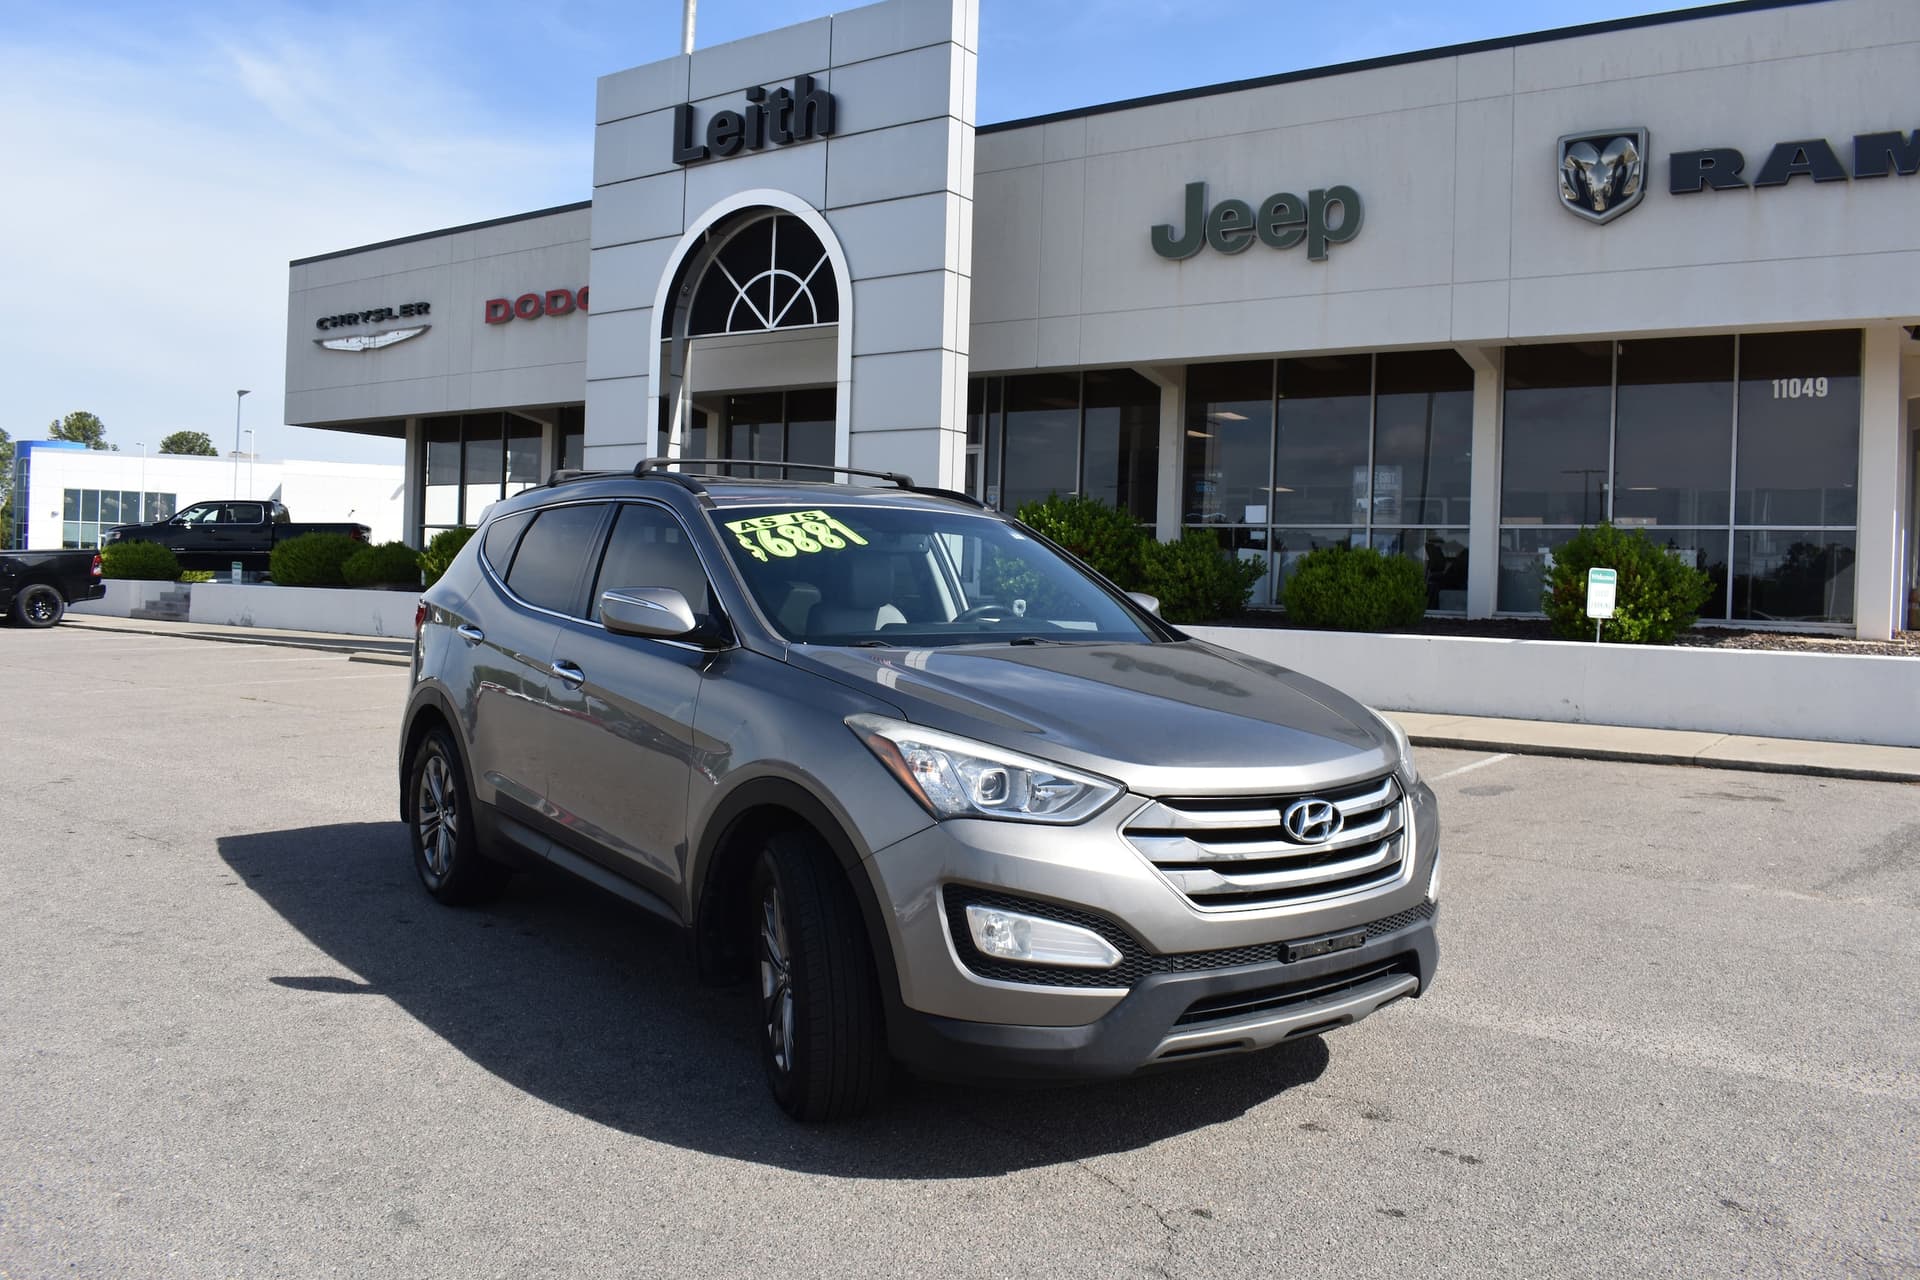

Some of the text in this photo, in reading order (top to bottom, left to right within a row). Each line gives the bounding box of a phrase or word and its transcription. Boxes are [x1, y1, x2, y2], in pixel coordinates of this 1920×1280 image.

[672, 73, 836, 165] Leith
[1669, 128, 1920, 195] RAM
[1151, 181, 1364, 261] Jeep
[316, 301, 431, 330] CHRYSLER
[1772, 377, 1829, 399] 11049
[741, 512, 820, 531] AS IS
